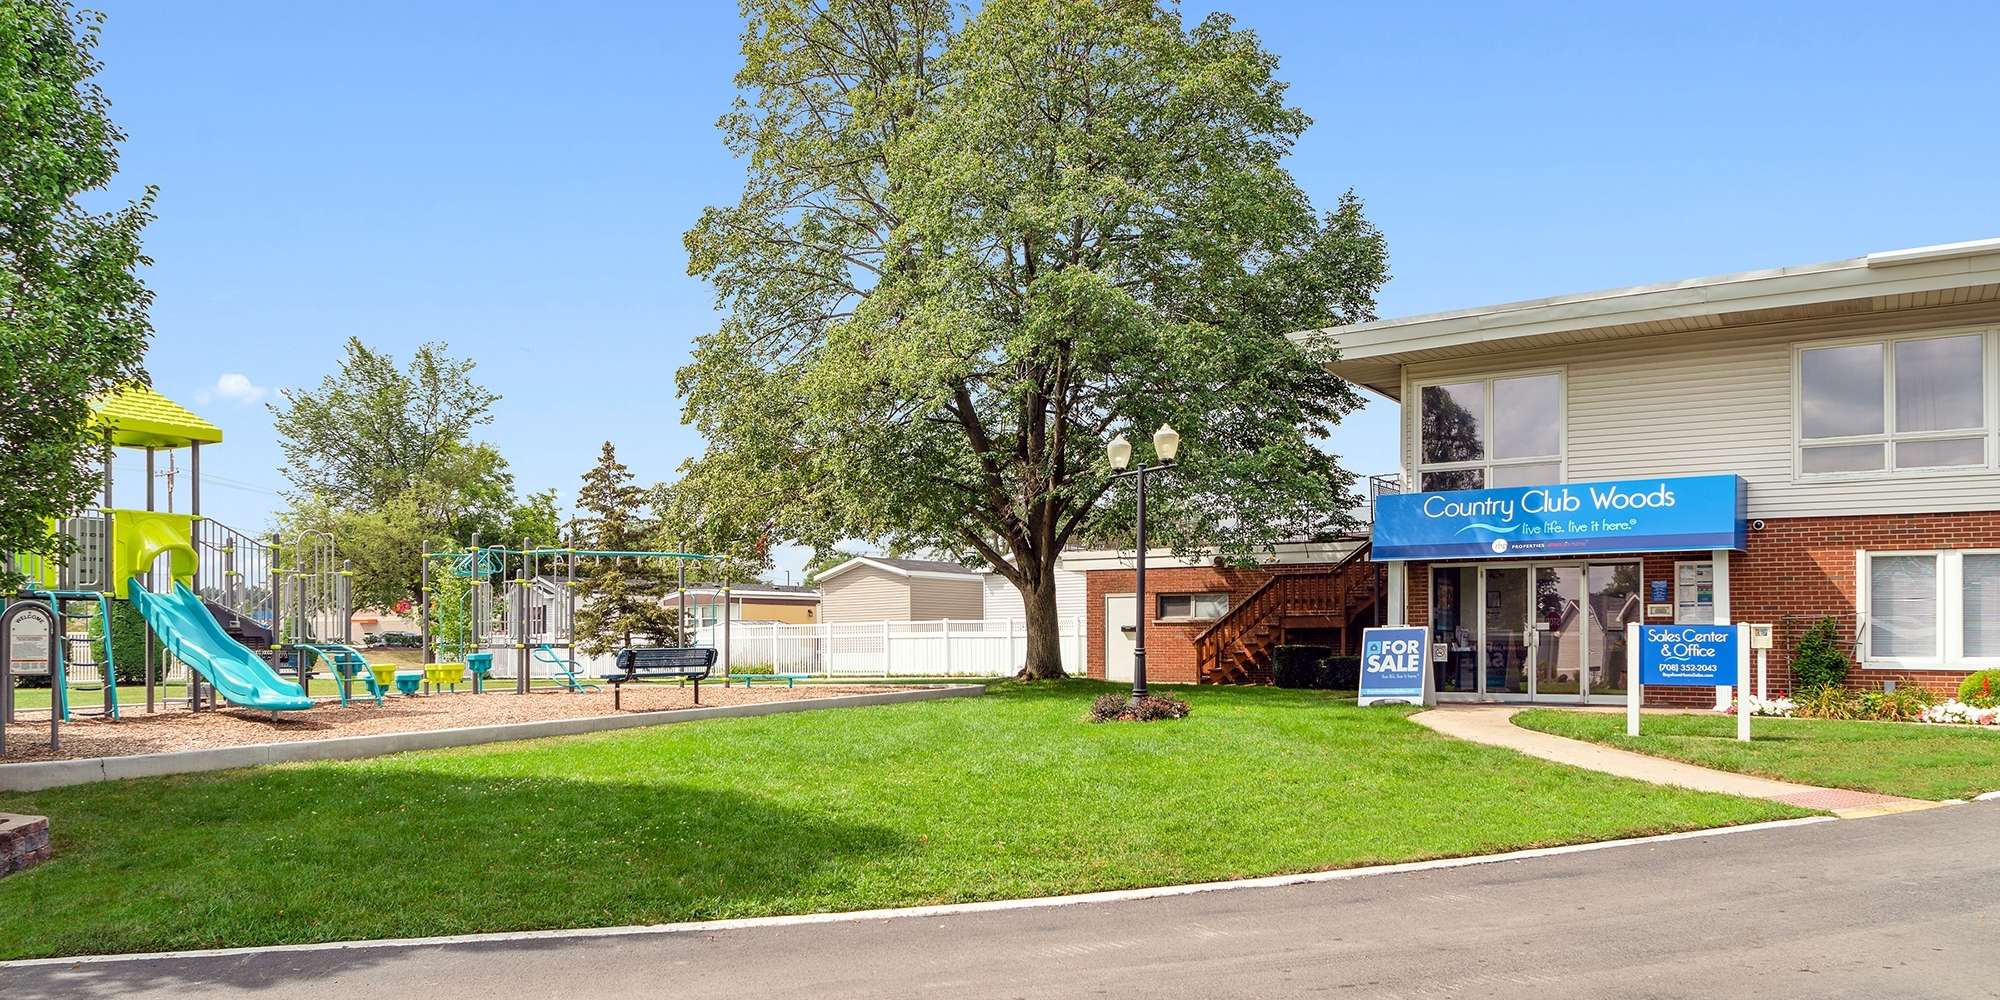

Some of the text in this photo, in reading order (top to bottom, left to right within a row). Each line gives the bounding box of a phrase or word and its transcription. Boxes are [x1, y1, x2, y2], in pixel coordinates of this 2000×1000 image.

[1423, 483, 1675, 523] Country Club Woods
[1522, 522, 1541, 535] live
[1544, 520, 1565, 534] life.
[1568, 520, 1588, 533] live
[1591, 520, 1599, 532] it
[15, 614, 45, 625] WELCOME
[1648, 629, 1729, 642] Sales Center
[1381, 640, 1419, 655] FOR
[1661, 643, 1715, 657] & Office
[1366, 654, 1419, 673] SALE
[1659, 663, 1717, 672] (708) 352-2043
